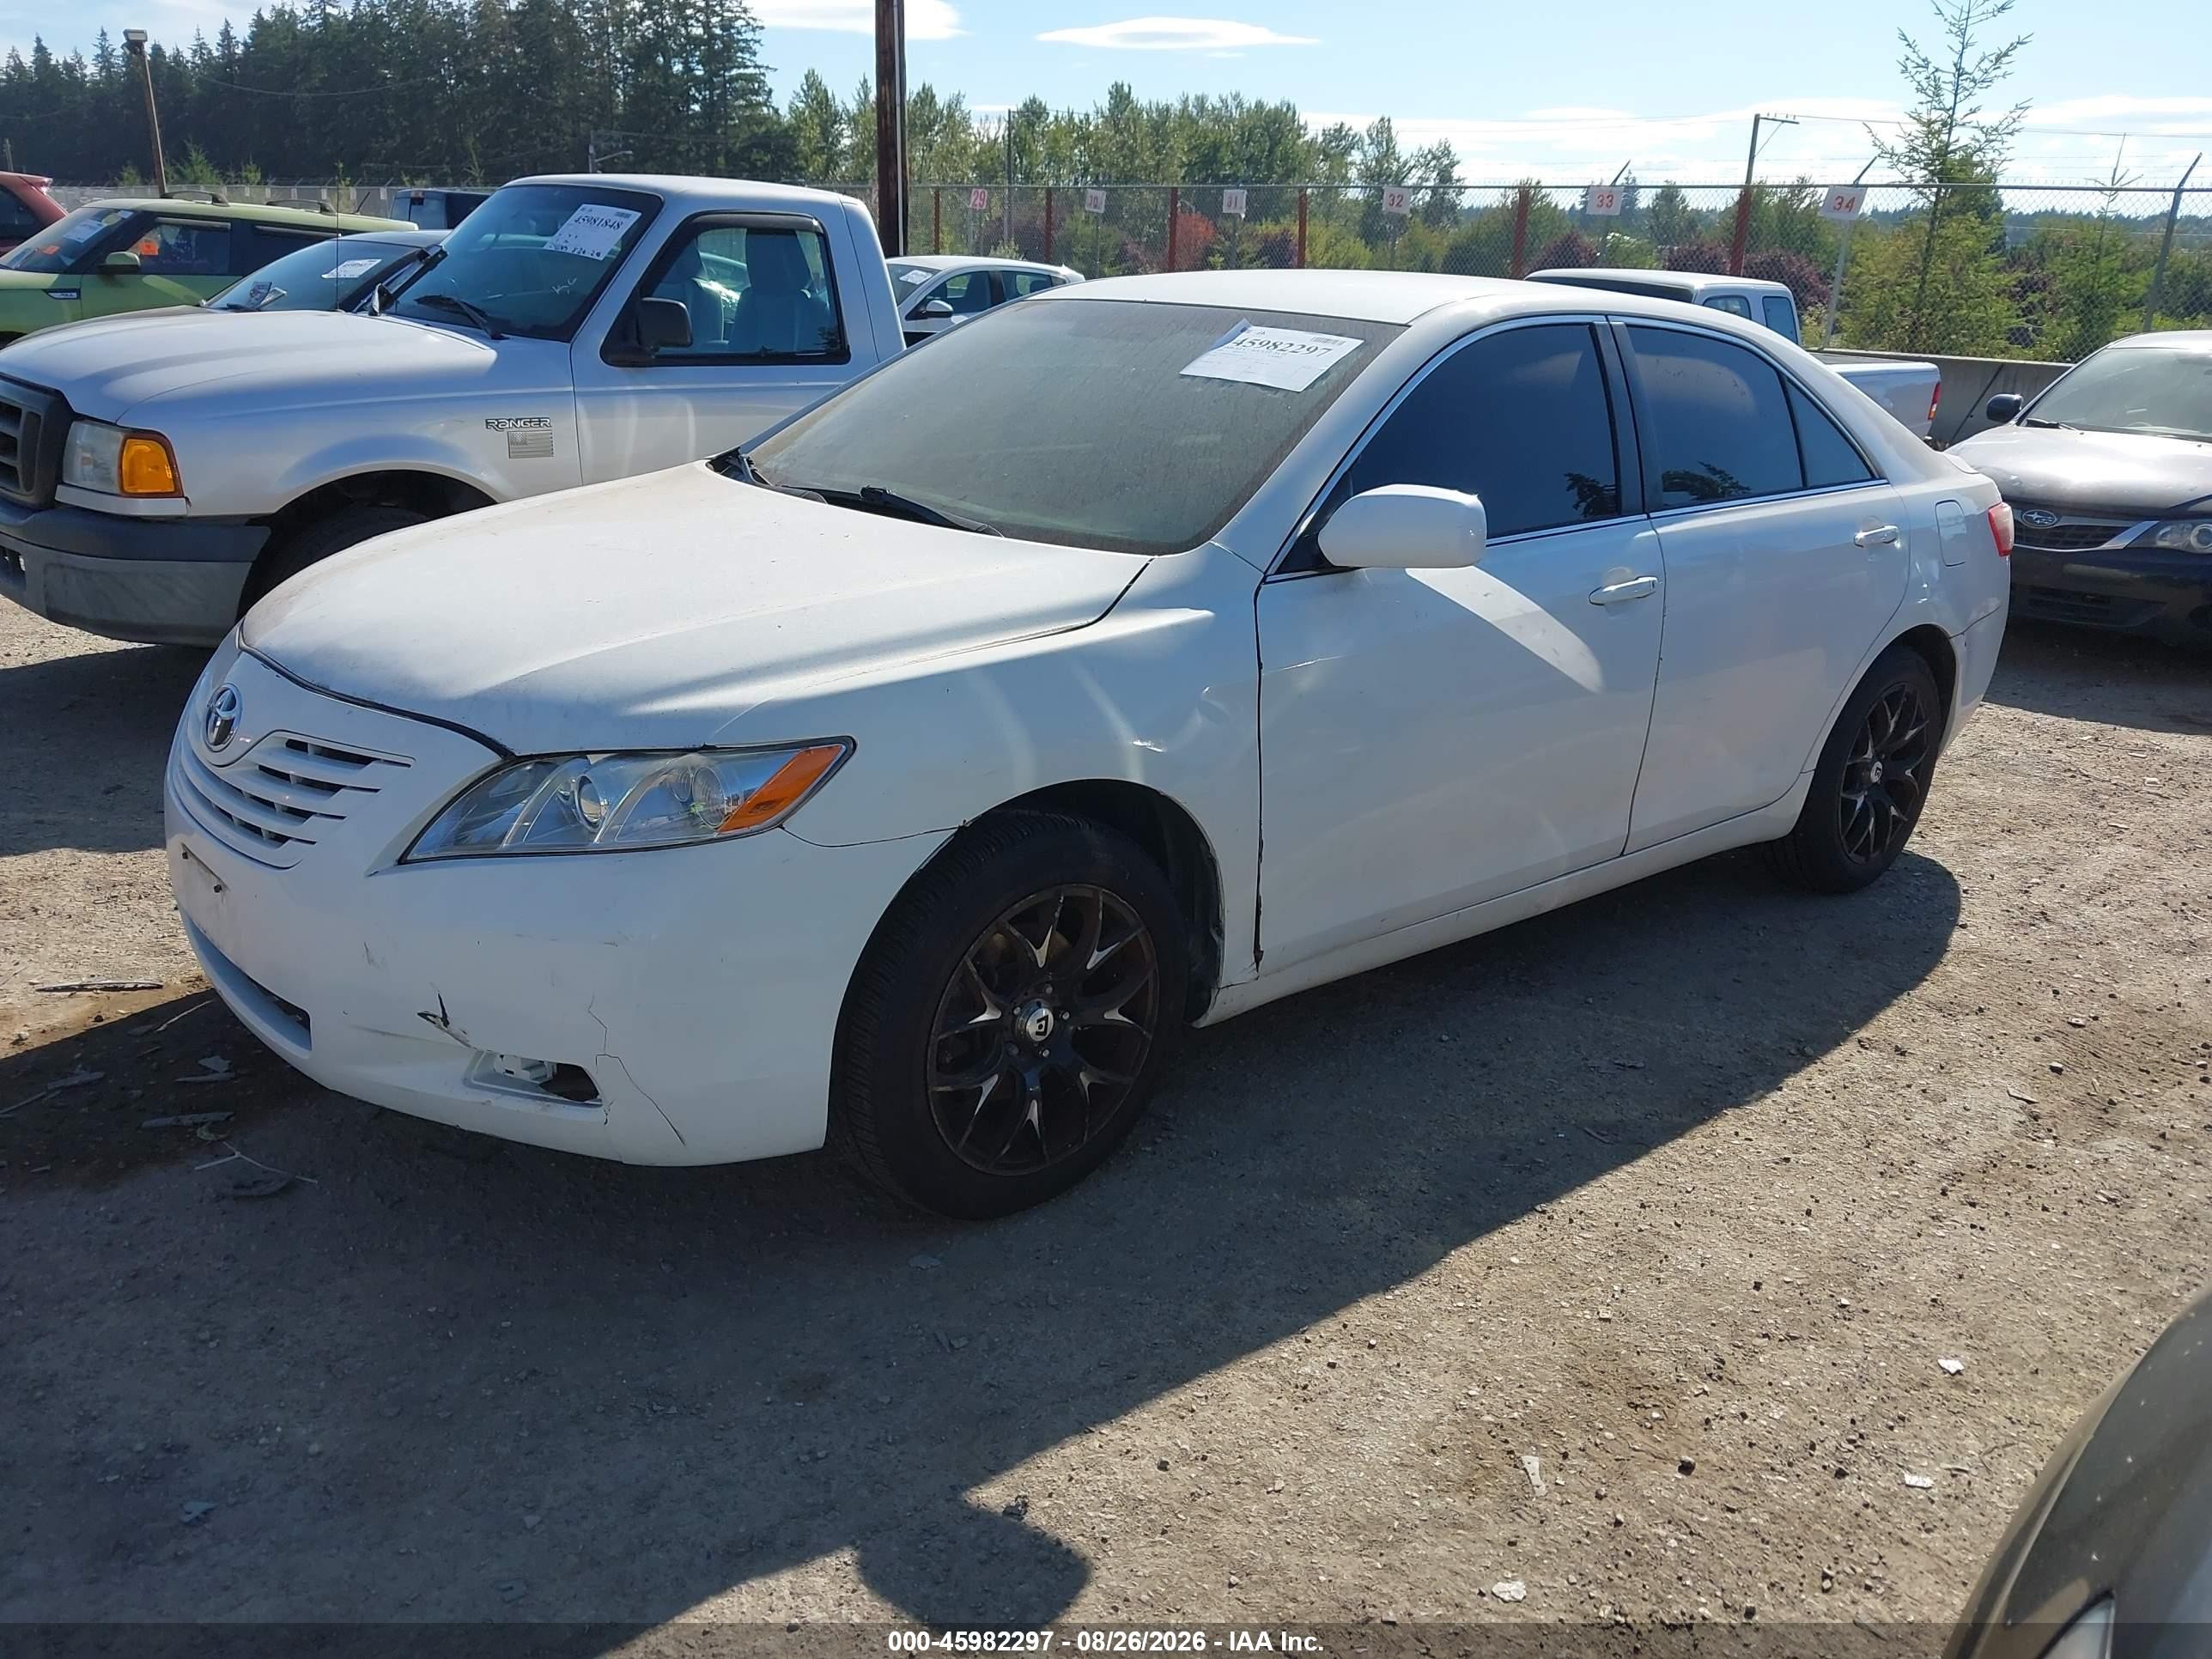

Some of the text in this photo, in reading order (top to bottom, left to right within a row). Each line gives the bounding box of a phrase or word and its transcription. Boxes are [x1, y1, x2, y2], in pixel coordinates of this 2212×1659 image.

[972, 190, 986, 208] 29
[1388, 193, 1404, 208] 32
[1596, 193, 1614, 209] 33
[1832, 196, 1856, 213] 34
[1233, 337, 1333, 357] 45982297
[485, 417, 552, 432] RANGER
